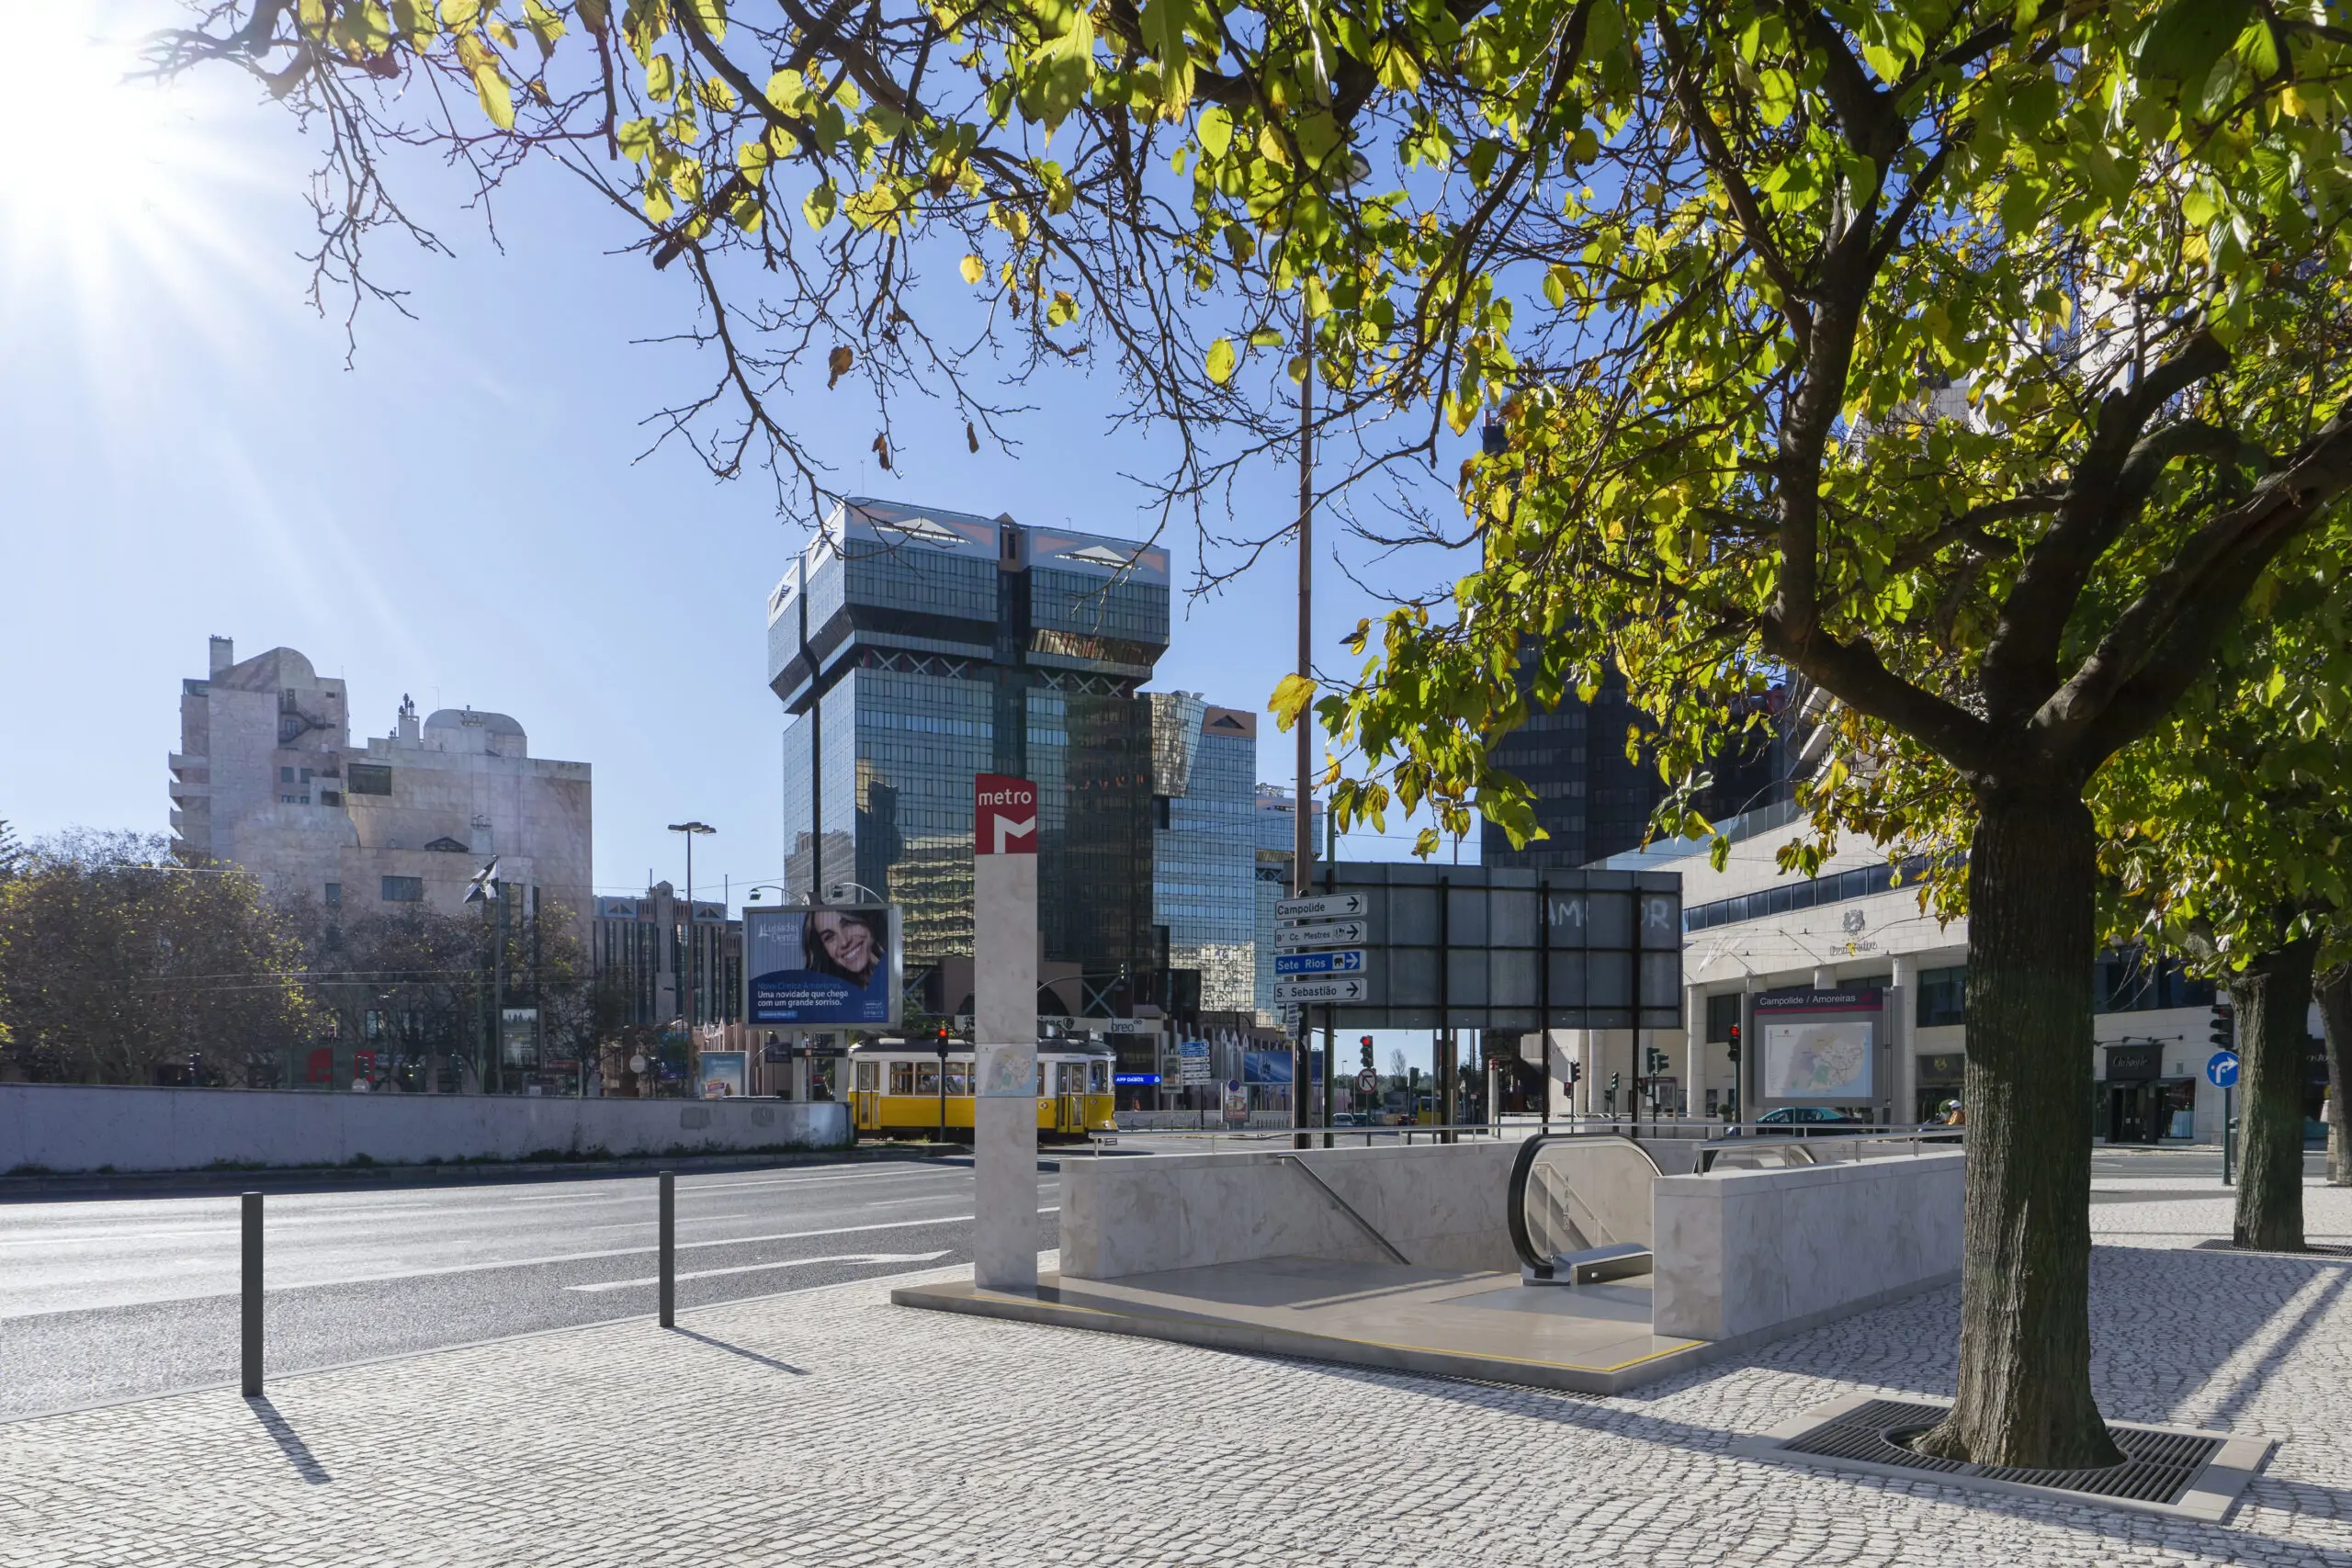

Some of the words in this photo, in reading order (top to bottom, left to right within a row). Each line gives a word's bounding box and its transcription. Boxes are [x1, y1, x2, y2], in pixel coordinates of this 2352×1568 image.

[978, 789, 1032, 806] metro
[1277, 902, 1326, 916] Campolide
[1304, 931, 1330, 941] Mestres
[1277, 960, 1299, 970] Sete
[1305, 958, 1326, 968] Rios
[775, 990, 809, 998] novidade
[810, 991, 824, 999] que
[826, 989, 848, 999] chega
[1276, 987, 1285, 998] S.
[1291, 986, 1337, 997] Sebastião
[787, 998, 813, 1009] grande
[815, 998, 842, 1007] sorriso.
[1759, 996, 1804, 1007] Campolide
[1812, 994, 1857, 1004] Amoreiras
